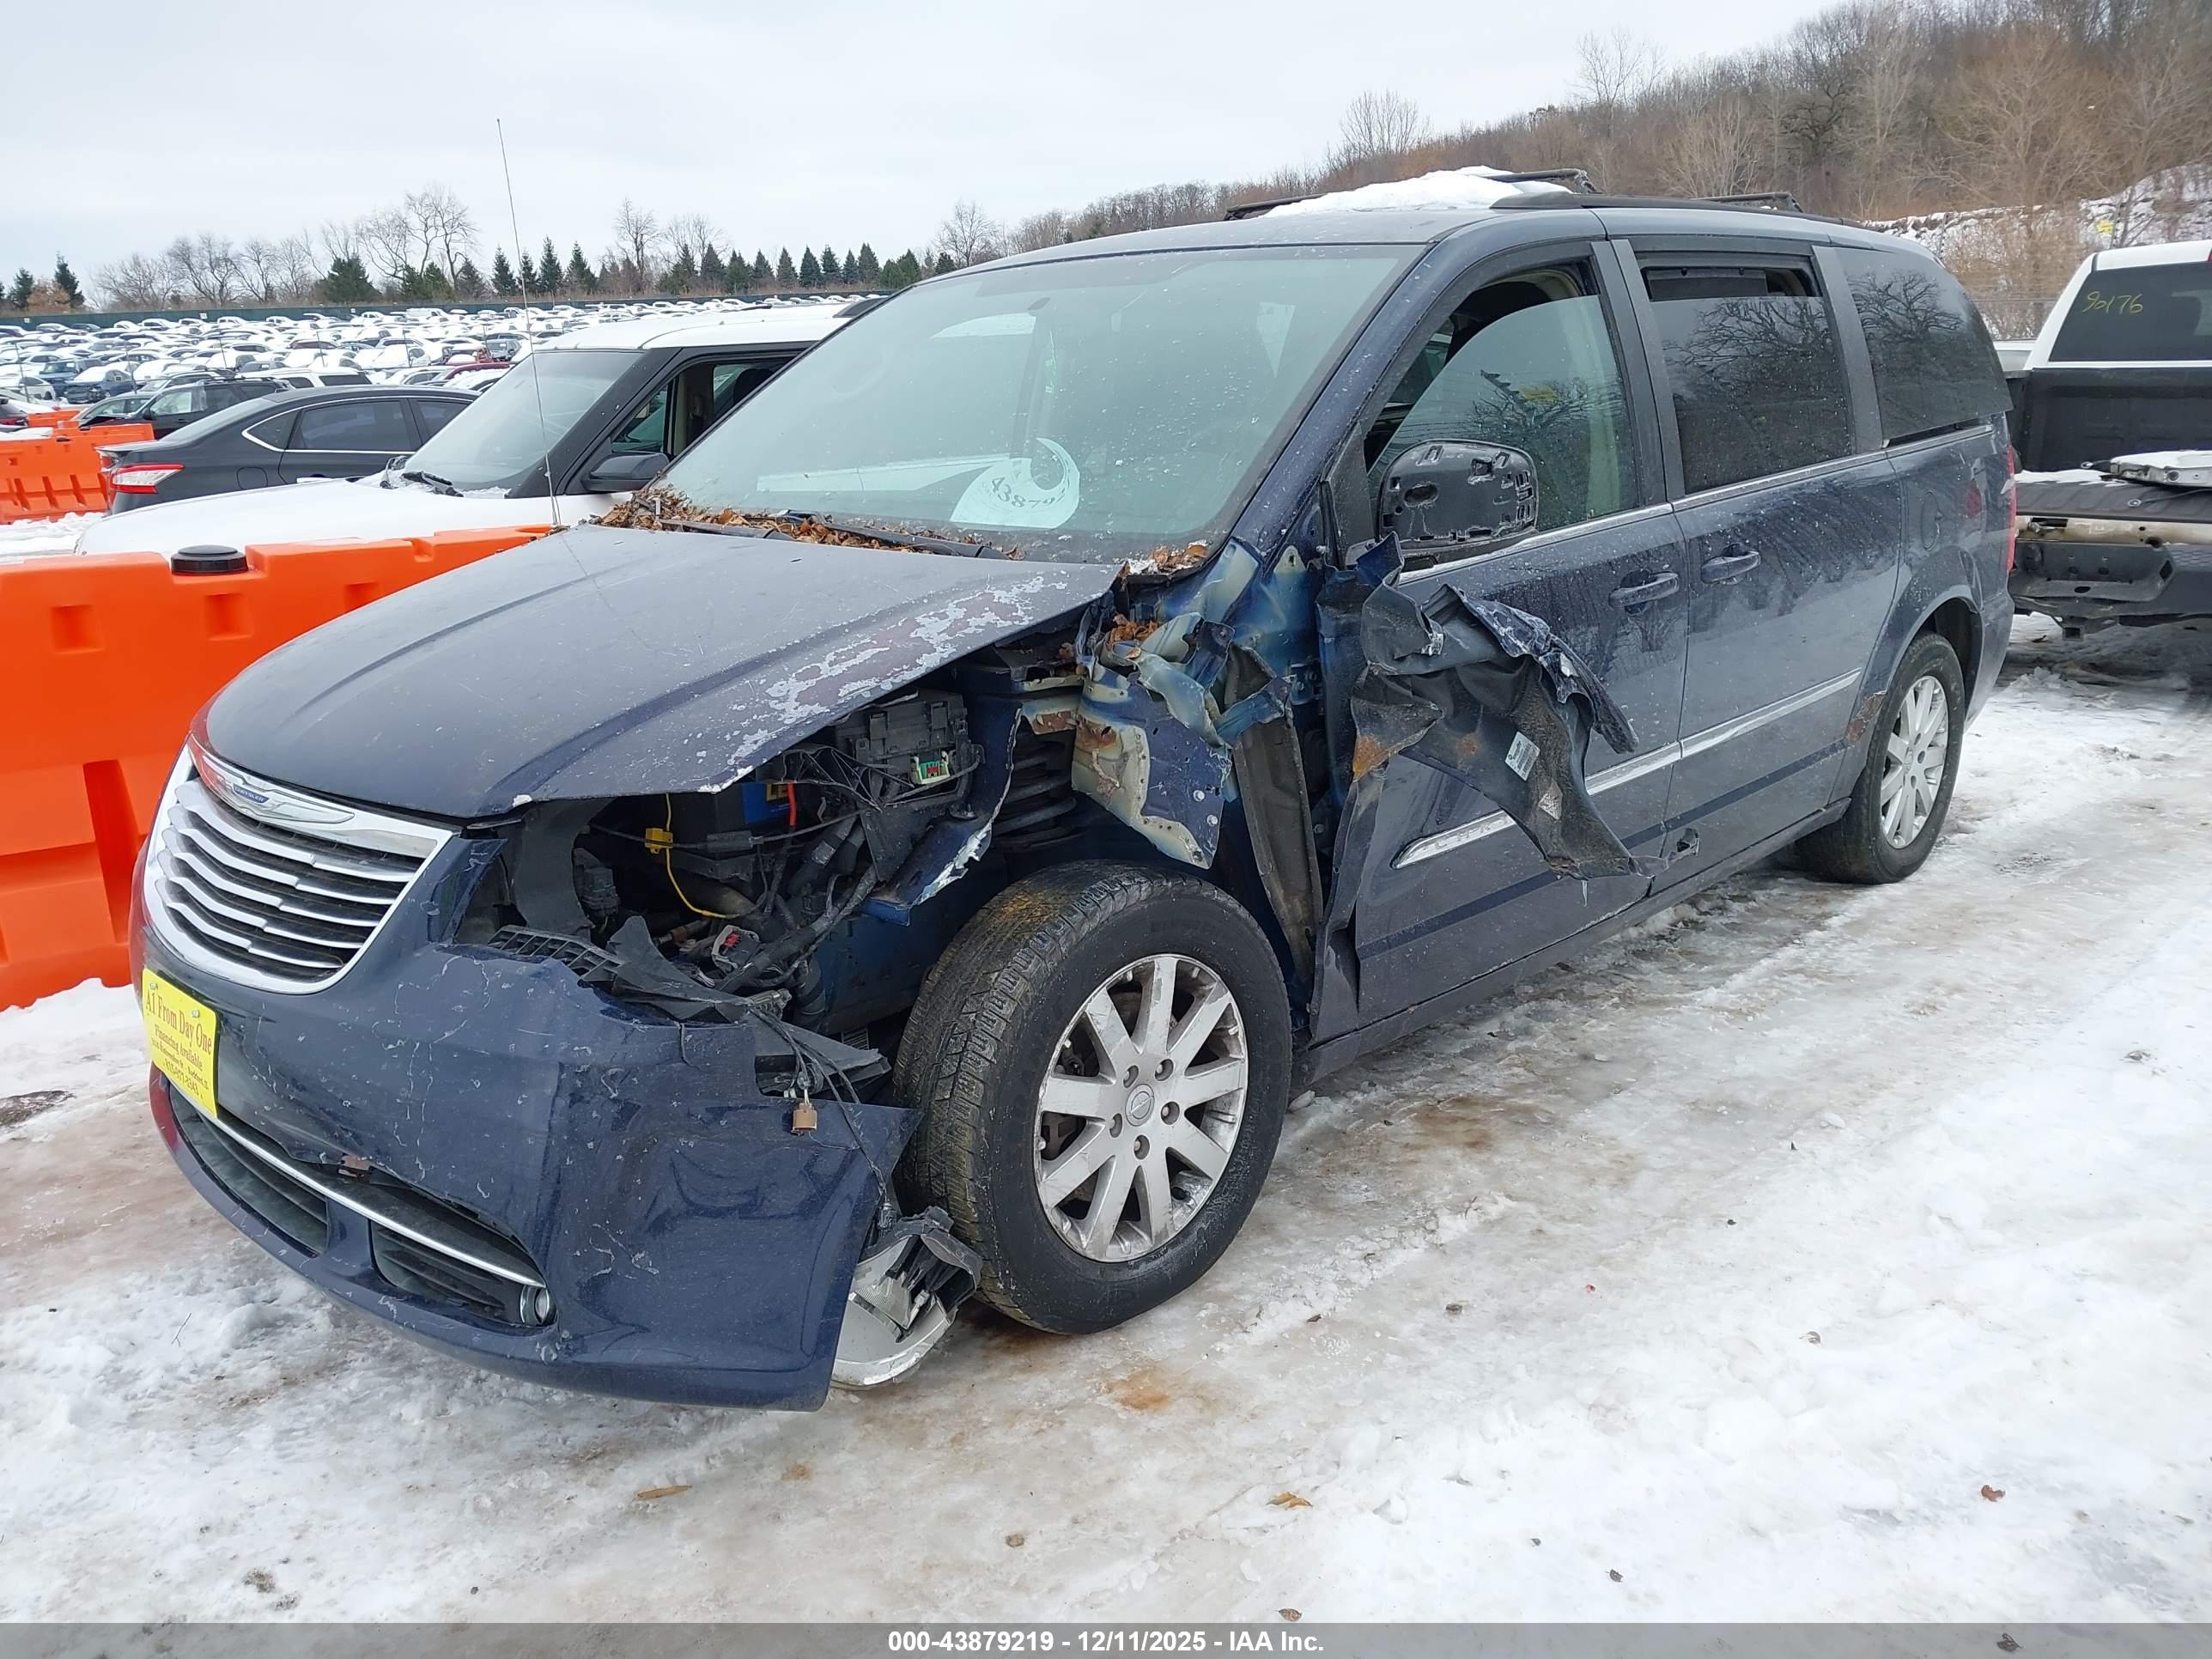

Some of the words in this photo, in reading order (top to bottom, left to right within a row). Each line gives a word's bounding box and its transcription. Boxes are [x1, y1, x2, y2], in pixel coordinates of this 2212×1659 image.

[2082, 291, 2143, 314] 90176
[146, 989, 156, 1015] A1
[157, 994, 178, 1030] From
[179, 1010, 194, 1047] Day
[196, 1024, 213, 1055] One
[155, 1024, 179, 1055] Financing
[179, 1044, 203, 1071] Available
